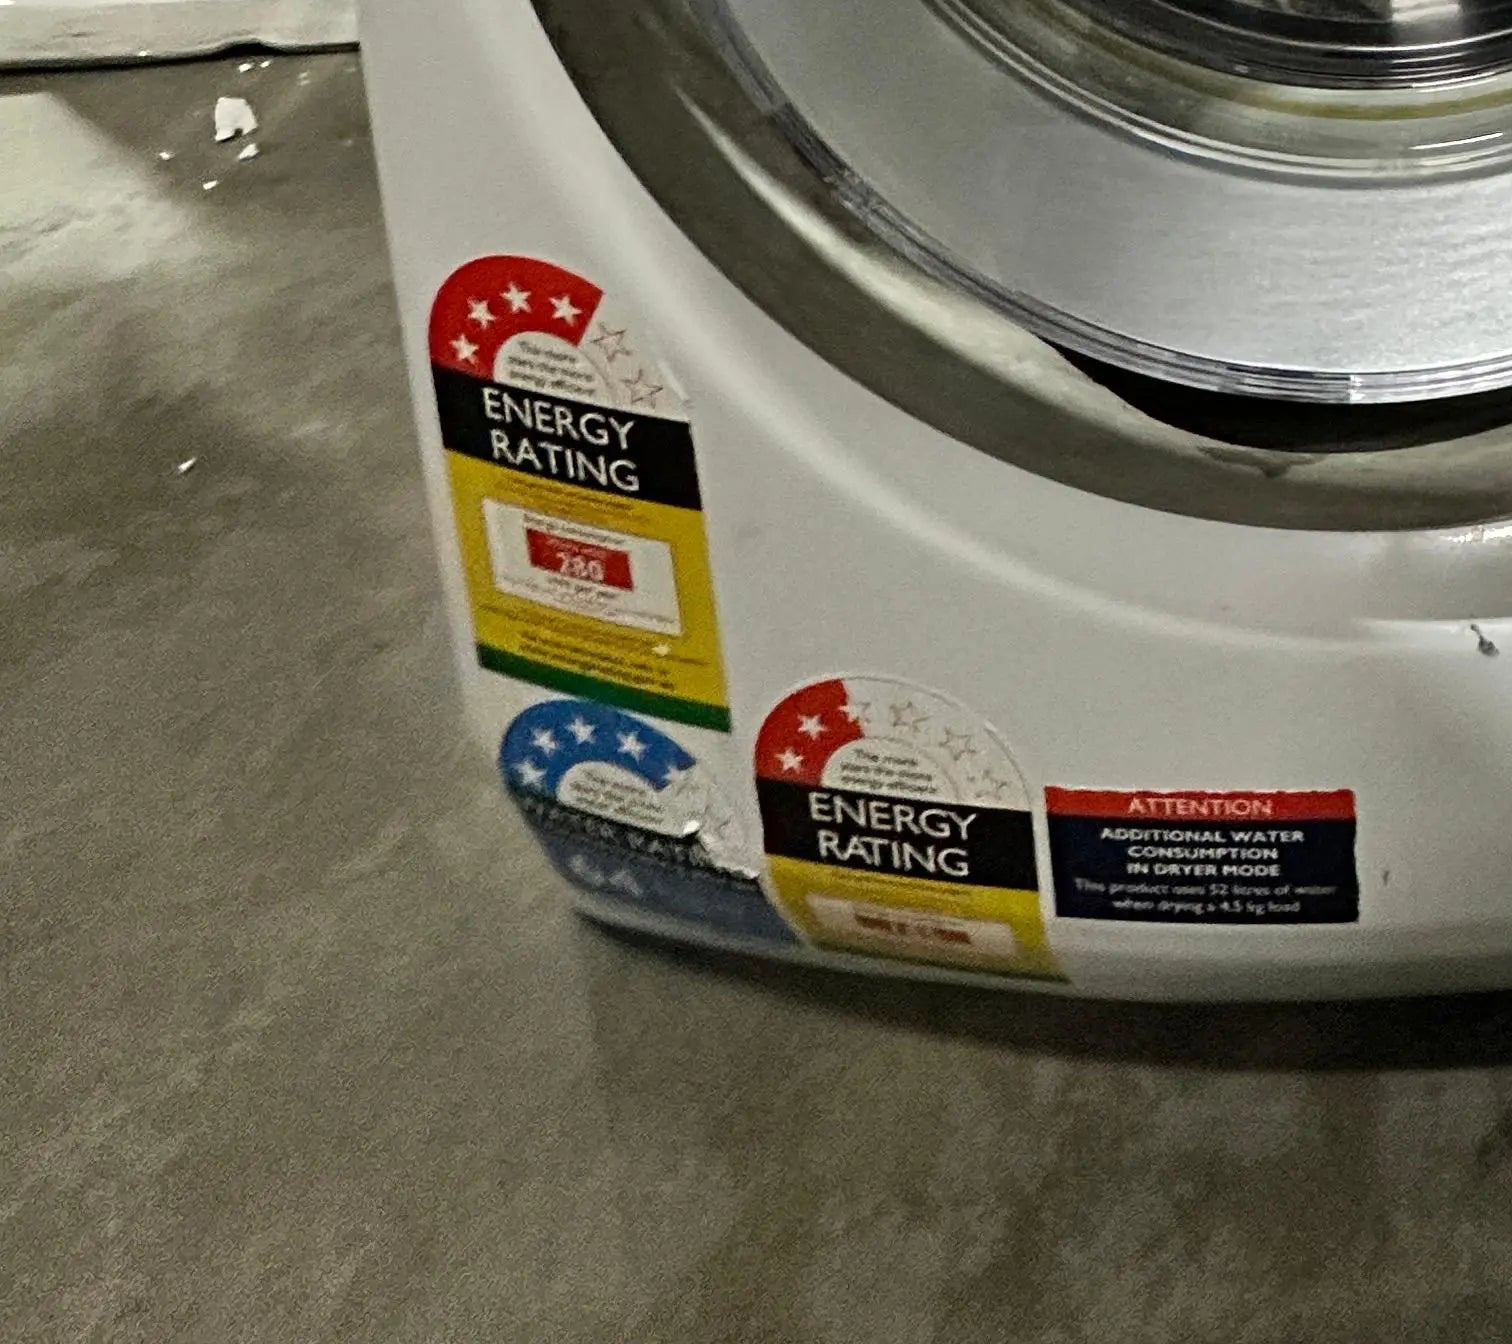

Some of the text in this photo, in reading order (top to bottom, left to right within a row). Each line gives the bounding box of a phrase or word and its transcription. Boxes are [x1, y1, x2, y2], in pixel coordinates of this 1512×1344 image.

[483, 387, 636, 450] ENERGY
[490, 429, 639, 492] RATING
[811, 792, 976, 840] ENERGY
[1127, 798, 1273, 815] ATTENTION
[1100, 827, 1304, 843] ADDITIONAL WATER
[818, 833, 970, 877] RATING
[1127, 846, 1278, 860] CONSUMPTION
[1126, 863, 1281, 877] IN DRYER MODE
